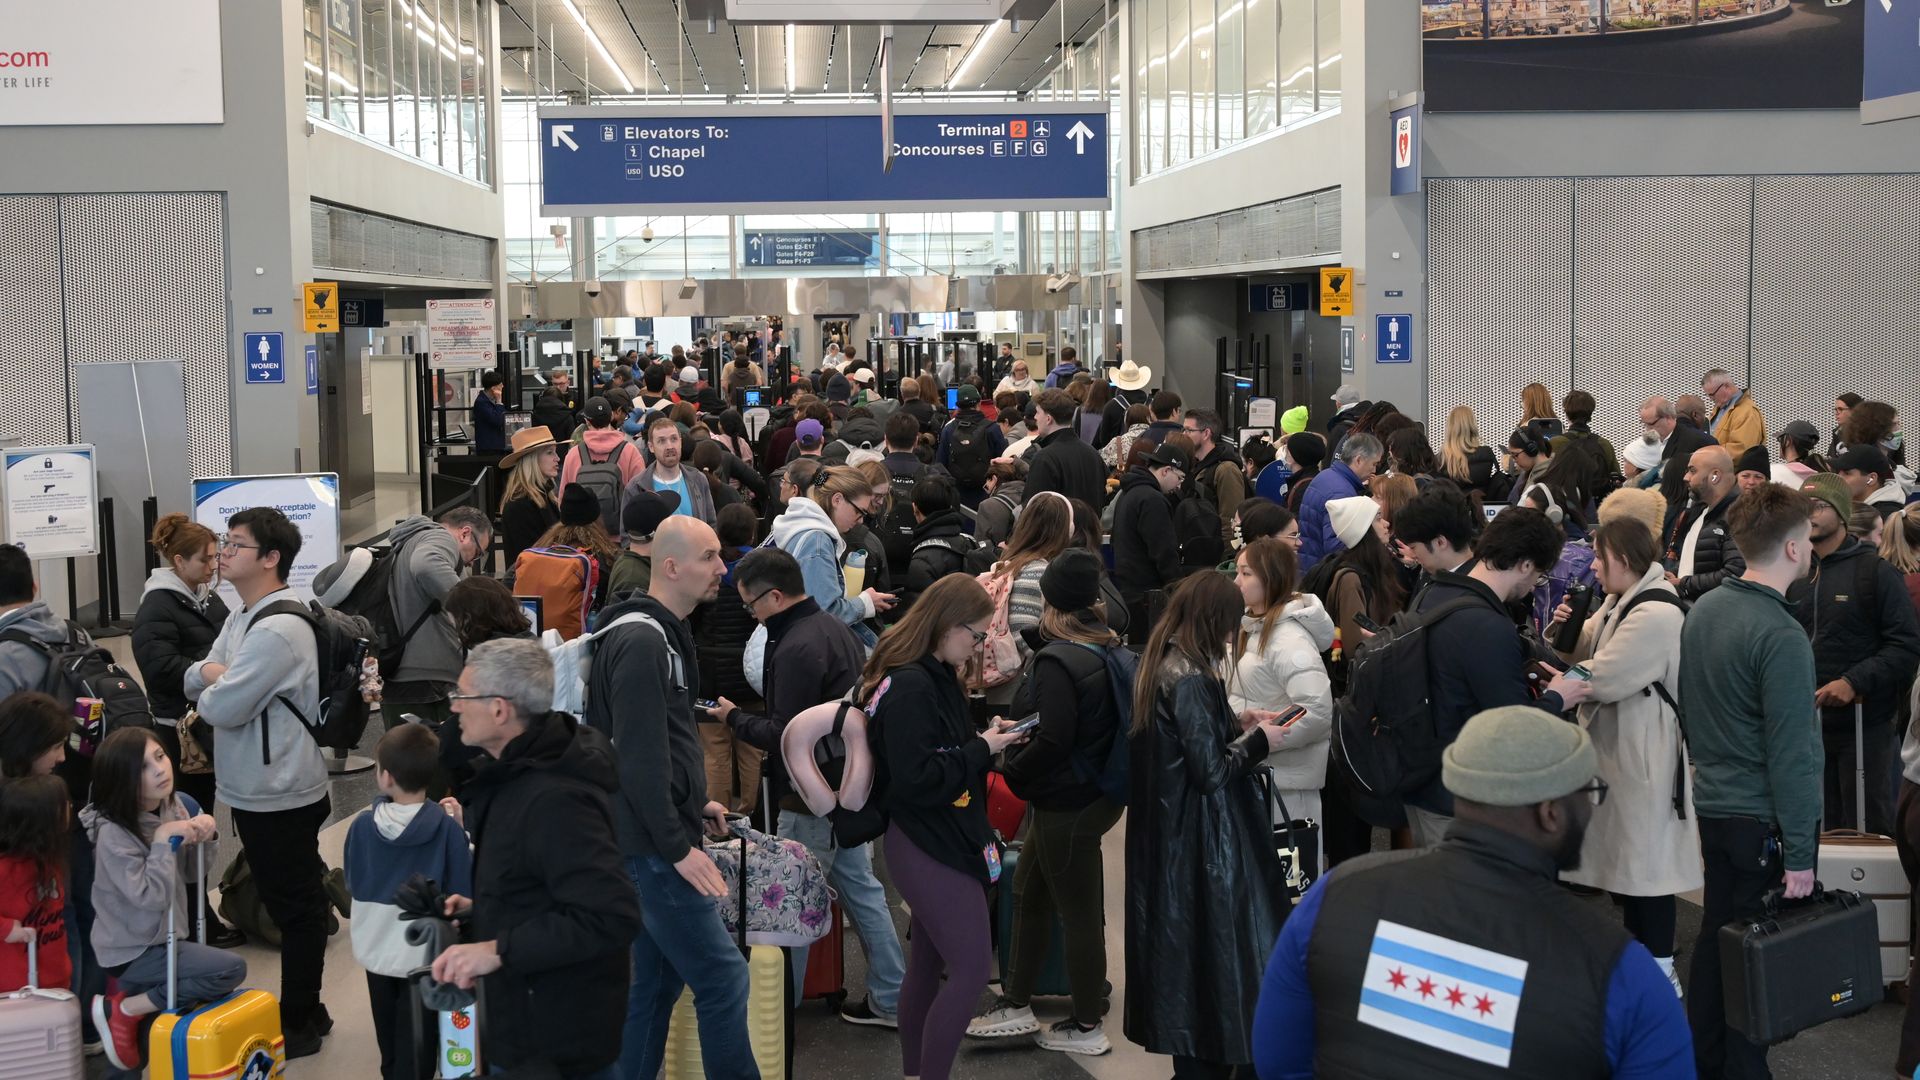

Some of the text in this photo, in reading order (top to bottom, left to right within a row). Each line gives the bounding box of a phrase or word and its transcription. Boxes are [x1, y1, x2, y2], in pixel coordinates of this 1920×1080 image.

[0, 77, 50, 88] ER LIFE
[938, 123, 1005, 137] Terminal
[1399, 120, 1408, 131] AED
[624, 125, 729, 140] Elevators To:
[648, 145, 705, 161] Chapel
[993, 143, 1003, 155] E
[1014, 142, 1023, 154] F
[1033, 142, 1045, 155] G
[649, 164, 685, 178] USO
[219, 506, 240, 515] Don't
[275, 504, 316, 512] Acceptable
